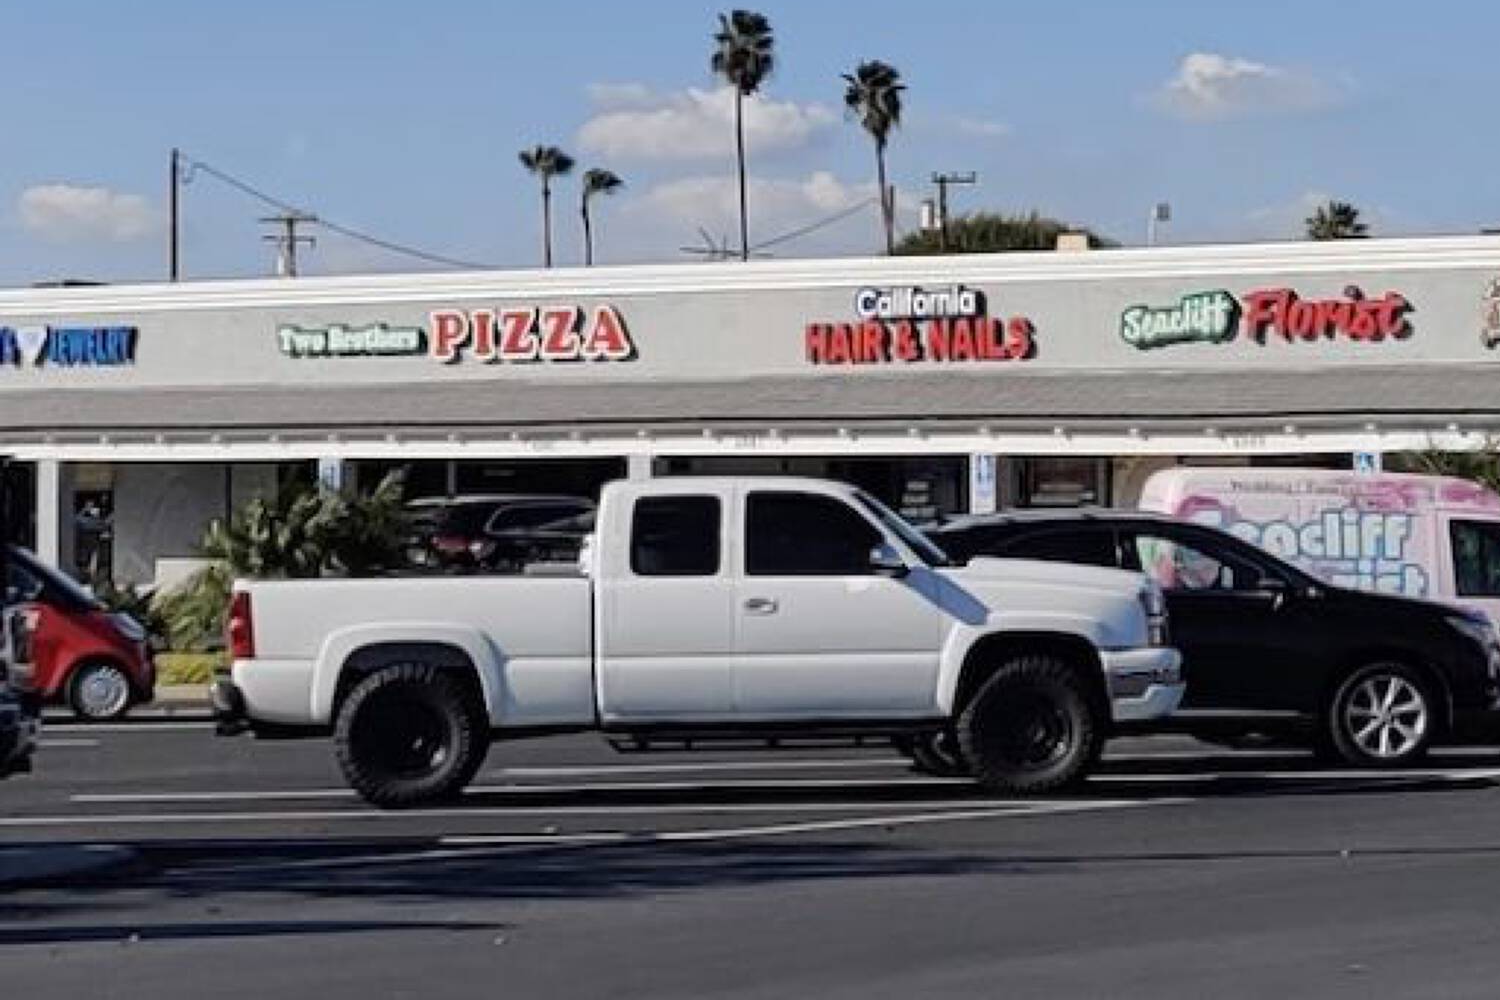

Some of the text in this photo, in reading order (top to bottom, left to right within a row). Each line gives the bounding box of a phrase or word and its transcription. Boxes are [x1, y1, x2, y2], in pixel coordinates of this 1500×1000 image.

[857, 286, 984, 318] California
[1242, 286, 1413, 344] Florist
[431, 306, 638, 364] PIZZA
[805, 316, 1036, 364] HAIR & NAILS
